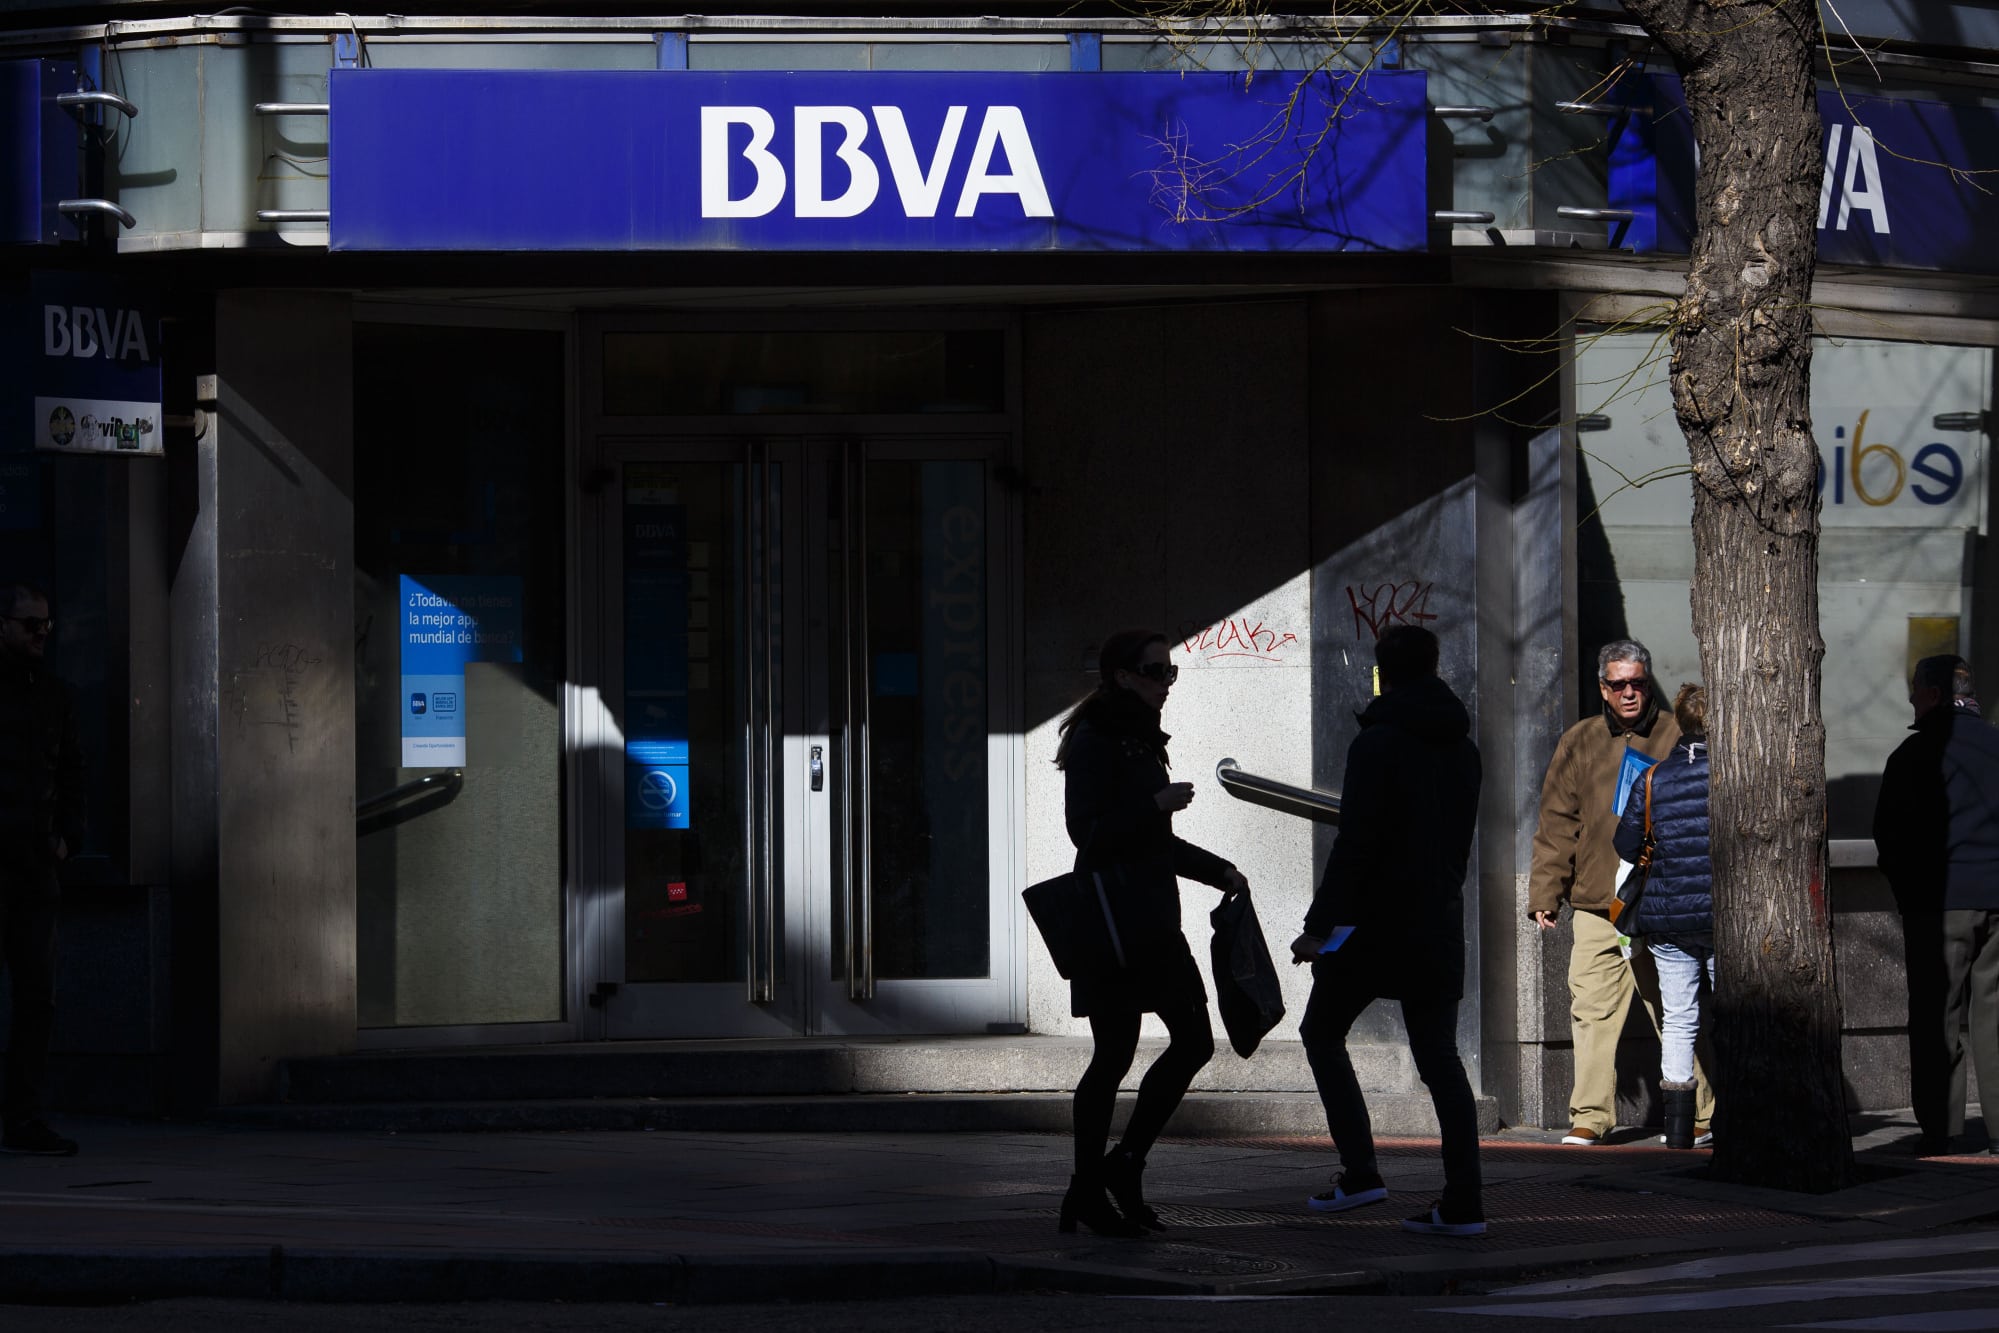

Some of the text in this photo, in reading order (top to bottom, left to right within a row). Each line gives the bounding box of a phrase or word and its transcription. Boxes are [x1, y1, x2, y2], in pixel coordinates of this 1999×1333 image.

[701, 105, 1055, 218] BBVA
[44, 304, 150, 361] BBVA
[409, 611, 480, 629] la mejor app
[409, 630, 455, 644] mundial
[457, 630, 472, 644] de
[930, 505, 984, 783] express
